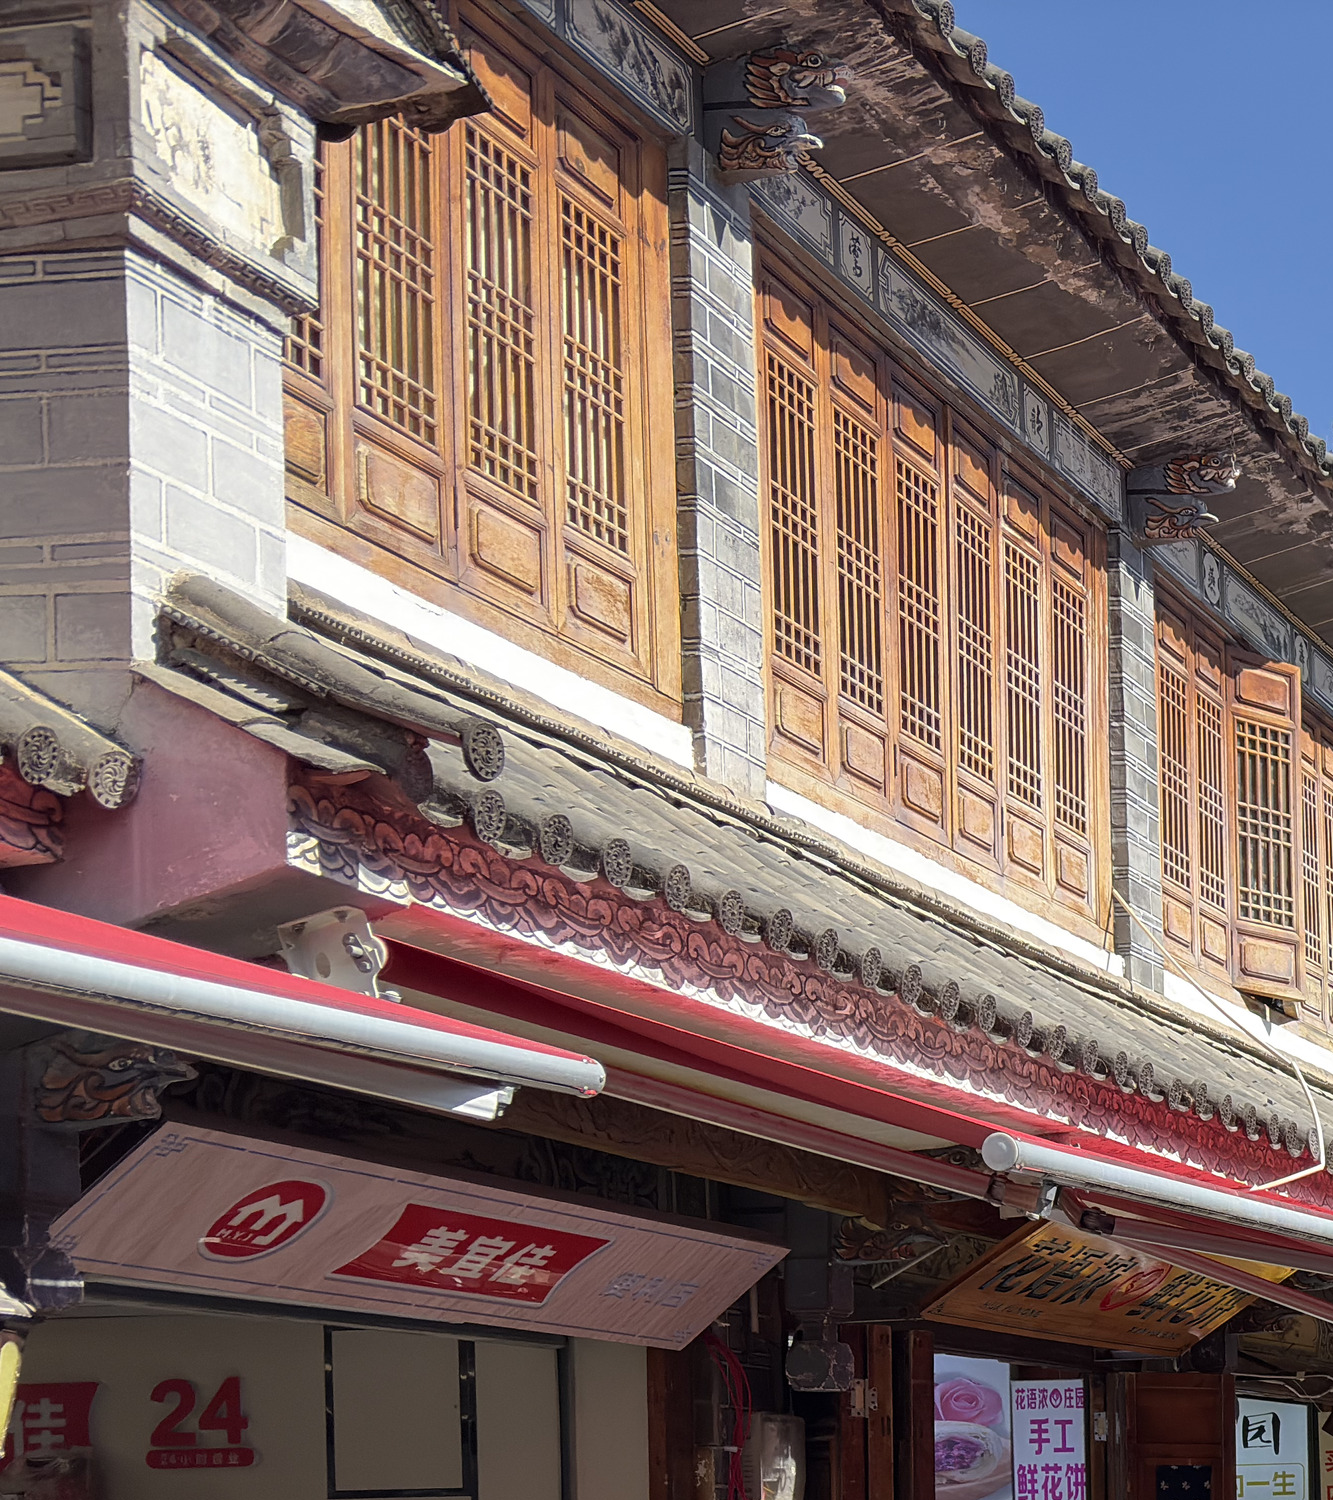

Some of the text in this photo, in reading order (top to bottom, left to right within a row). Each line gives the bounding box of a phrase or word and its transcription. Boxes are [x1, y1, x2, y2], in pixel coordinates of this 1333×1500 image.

[392, 1225, 558, 1287] 美宜佳
[978, 1237, 1139, 1306] 花语浓
[150, 1376, 249, 1447] 24
[1015, 1387, 1085, 1409] 花语浓 庄园
[1029, 1418, 1074, 1455] 手工
[1243, 1412, 1280, 1456] 园
